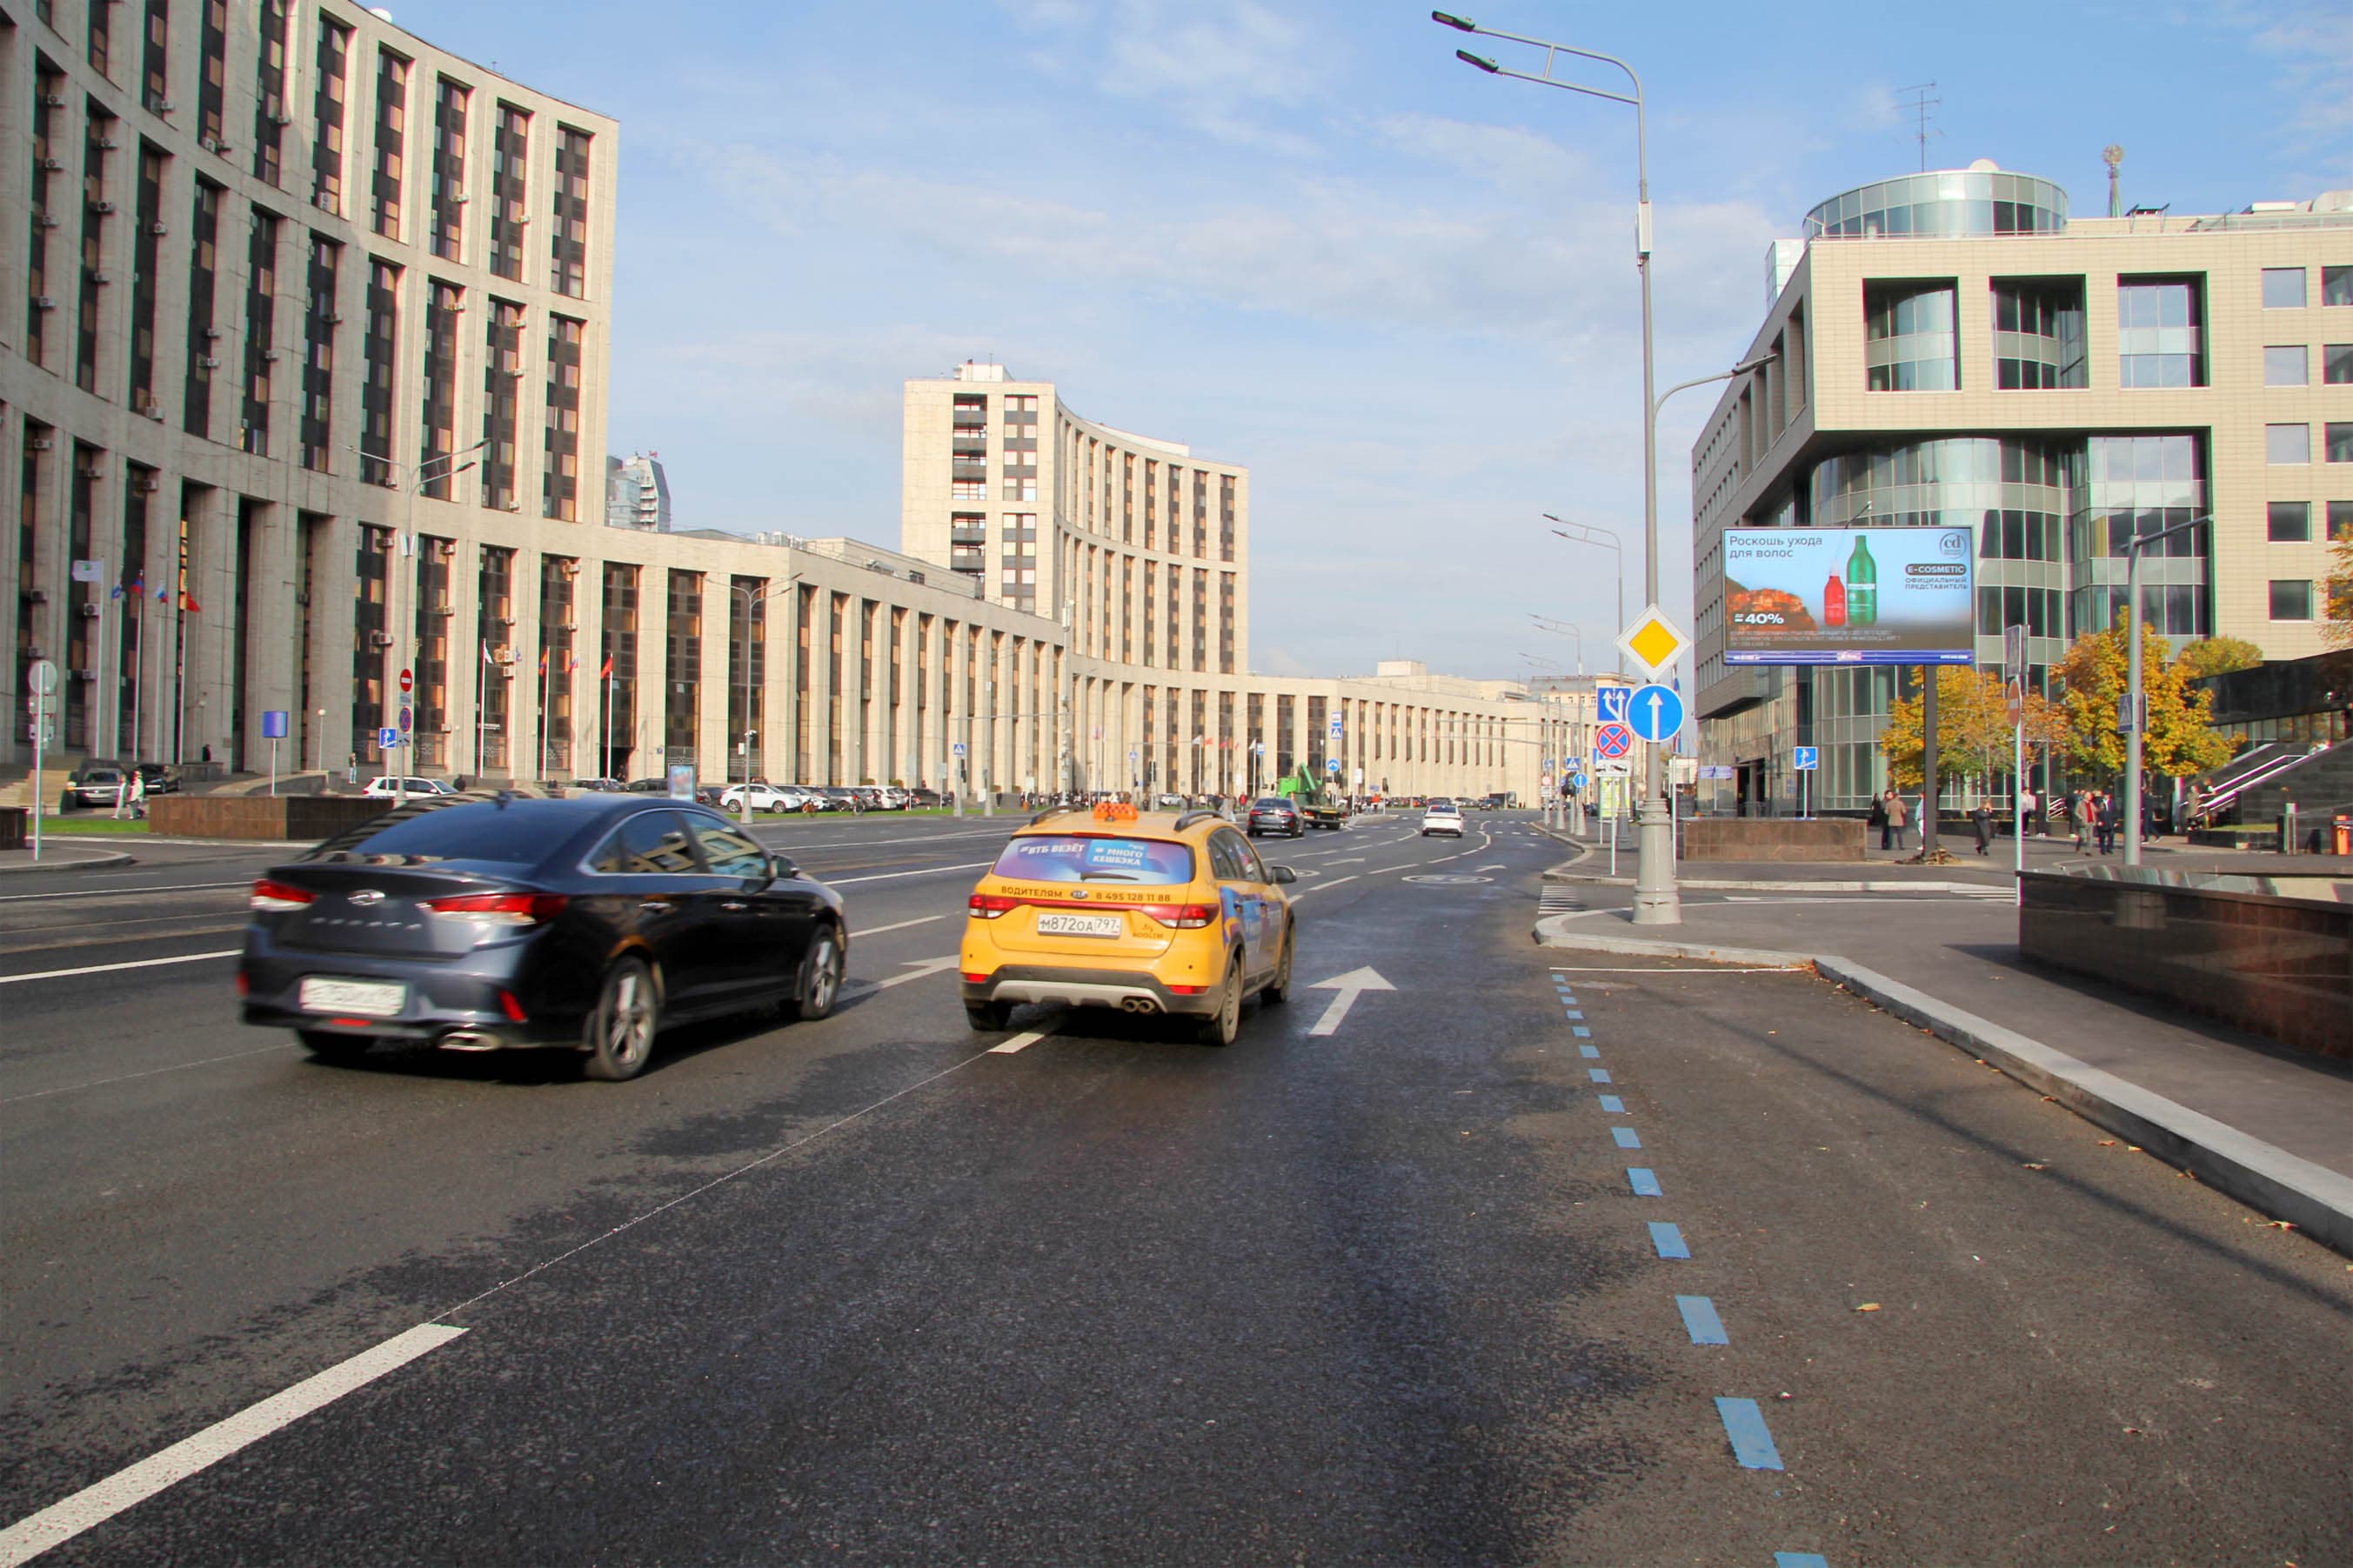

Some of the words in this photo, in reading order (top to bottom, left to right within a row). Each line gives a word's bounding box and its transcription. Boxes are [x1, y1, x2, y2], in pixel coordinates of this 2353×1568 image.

[1729, 536, 1784, 545] Роскошь
[1788, 537, 1822, 547] ухода
[1729, 550, 1752, 558] для
[1051, 843, 1086, 853] ВЕЗЁТ
[1107, 848, 1143, 857] МНОГО
[1093, 856, 1141, 865] КЕШБЭКА
[1001, 886, 1062, 897] ВОДИТЕЛЯМ
